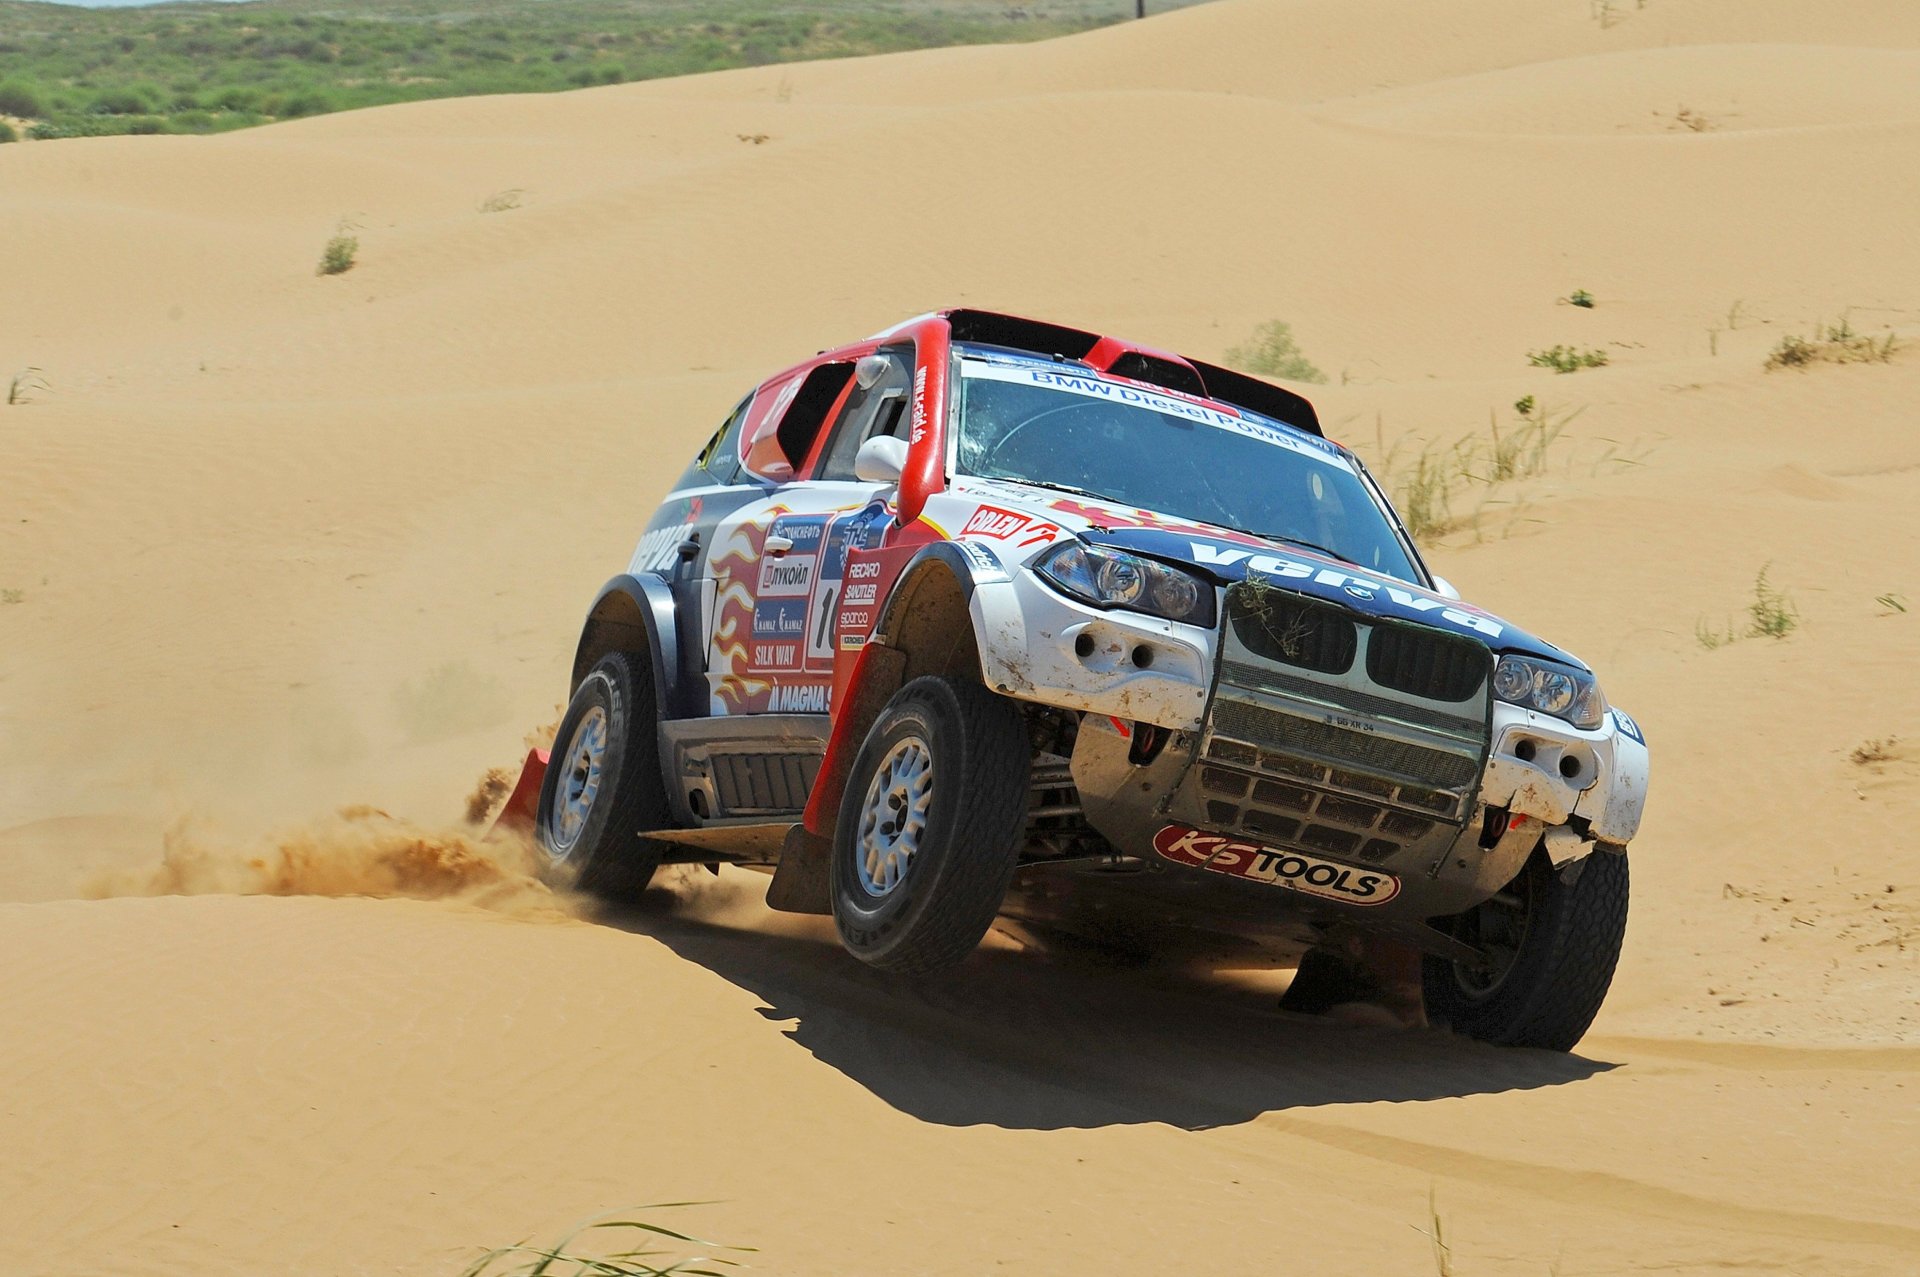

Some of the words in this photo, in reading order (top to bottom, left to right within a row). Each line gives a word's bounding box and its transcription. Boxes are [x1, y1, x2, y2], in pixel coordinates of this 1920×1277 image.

[1032, 370, 1111, 396] BMW
[1120, 389, 1210, 421] Diesel
[1216, 414, 1302, 450] Power
[966, 508, 1026, 537] ORLEN
[771, 564, 809, 585] ЛУКОЙЛ
[848, 562, 880, 579] RECARO
[1189, 541, 1504, 639] verva
[840, 611, 869, 629] sparco
[755, 645, 774, 666] SILK
[776, 645, 796, 666] WAY
[780, 685, 825, 712] MAGNA
[1167, 830, 1261, 866] KS
[1255, 849, 1381, 898] TOOLS
